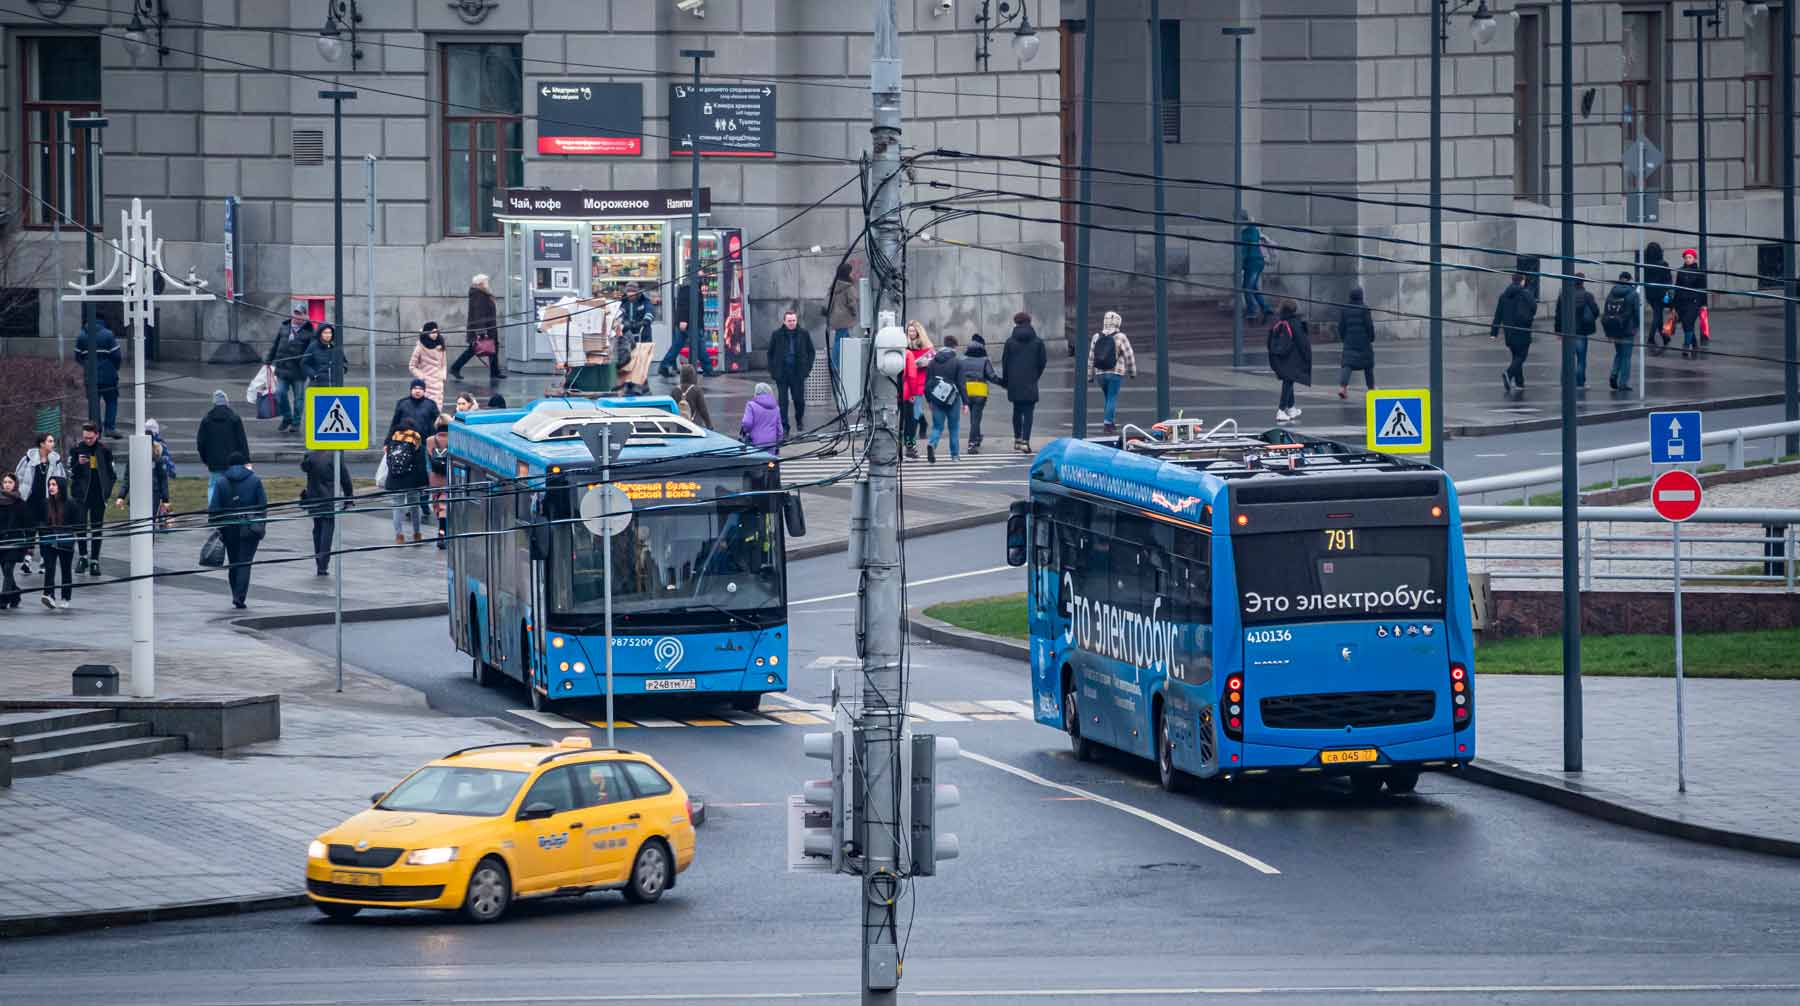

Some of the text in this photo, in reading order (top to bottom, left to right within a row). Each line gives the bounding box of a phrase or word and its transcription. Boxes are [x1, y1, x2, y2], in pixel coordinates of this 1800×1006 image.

[509, 197, 533, 210] Чай,
[535, 198, 562, 211] кофе
[583, 198, 650, 211] Мороженое
[1325, 530, 1355, 550] 791
[1245, 584, 1442, 613] Это электробус.
[1063, 571, 1184, 689] Это электробус.
[1247, 629, 1292, 643] 410136
